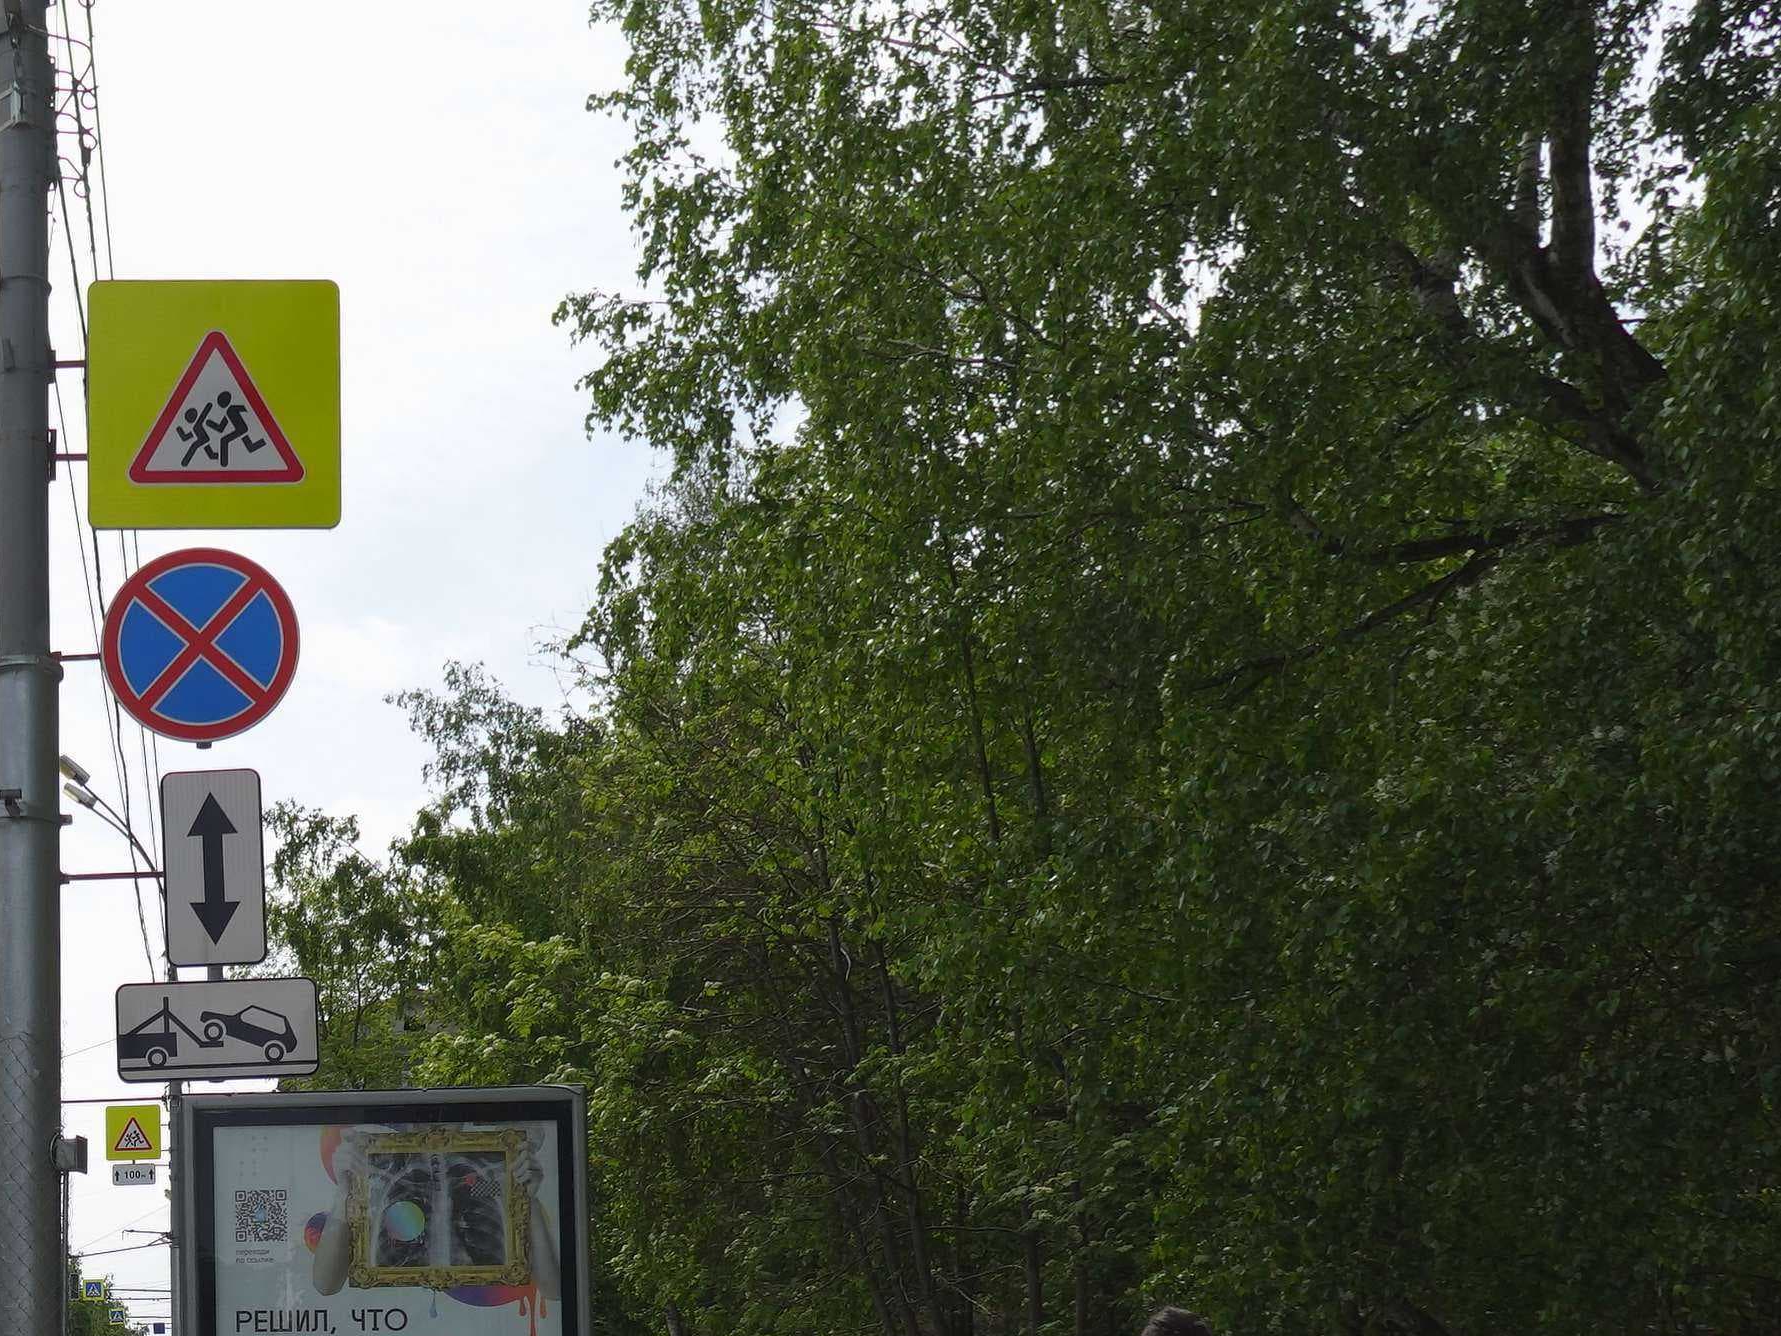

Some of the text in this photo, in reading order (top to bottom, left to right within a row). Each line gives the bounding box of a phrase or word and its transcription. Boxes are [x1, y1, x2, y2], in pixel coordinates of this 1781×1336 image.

[124, 1170, 141, 1179] 100
[235, 1308, 408, 1335] РЕШИЛ, ЧТО
